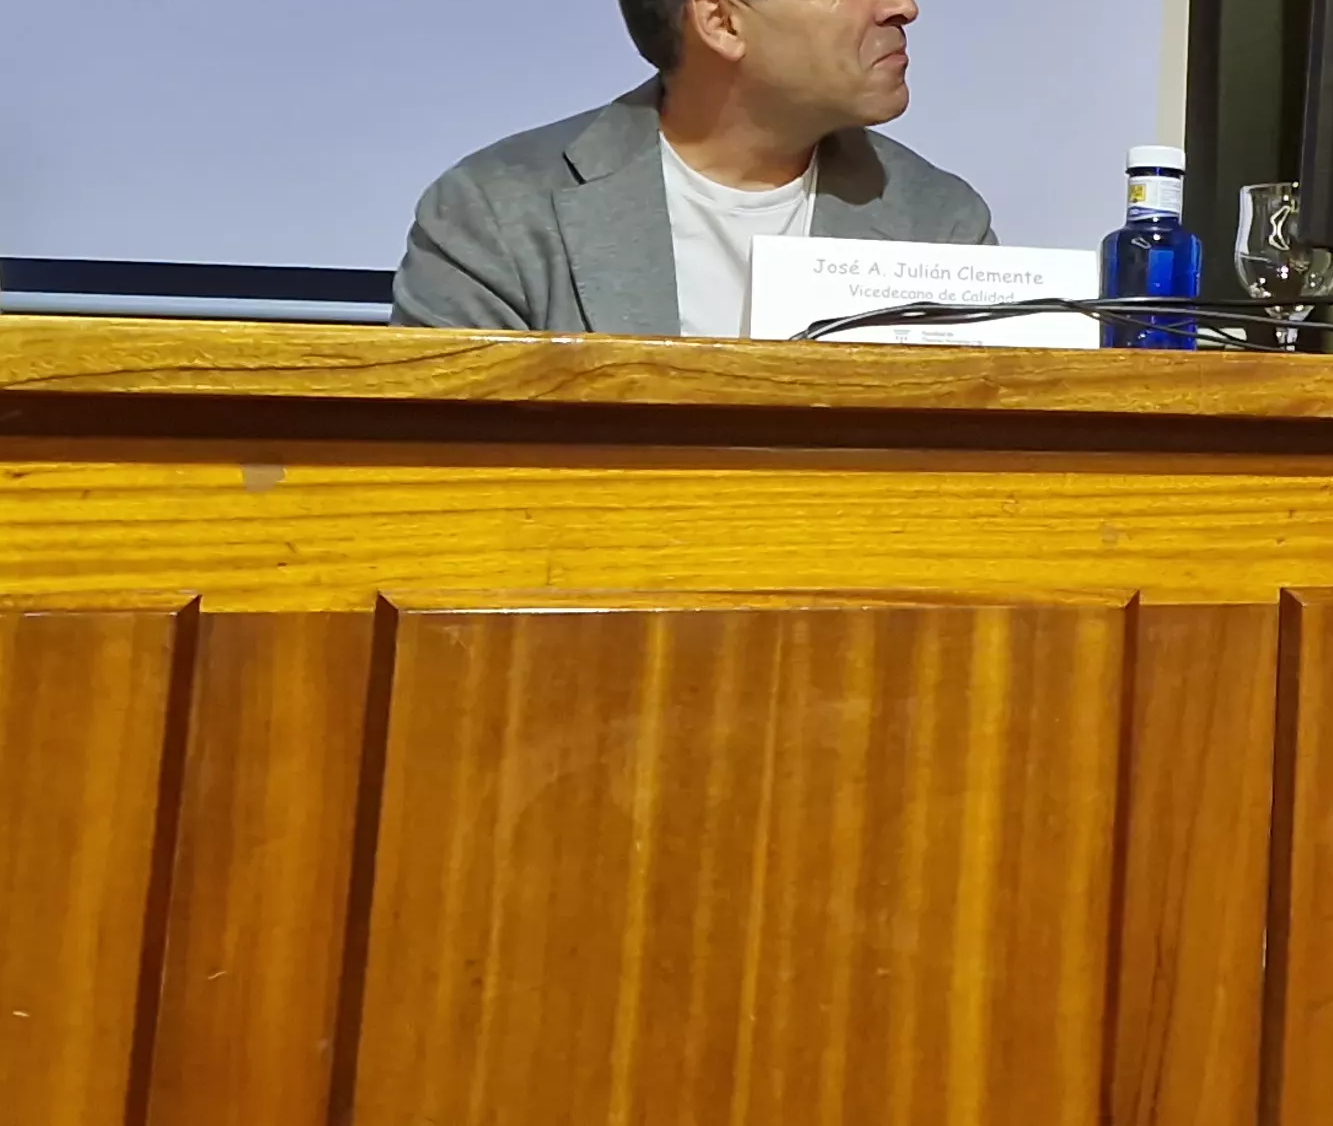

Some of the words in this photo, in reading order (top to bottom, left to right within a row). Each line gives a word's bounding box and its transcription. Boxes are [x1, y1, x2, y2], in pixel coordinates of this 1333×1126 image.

[812, 258, 860, 275] José
[868, 262, 886, 278] A.
[894, 262, 951, 281] Julián
[957, 266, 1044, 285] Clemente
[849, 284, 934, 300] Vicedecano
[938, 288, 956, 302] de
